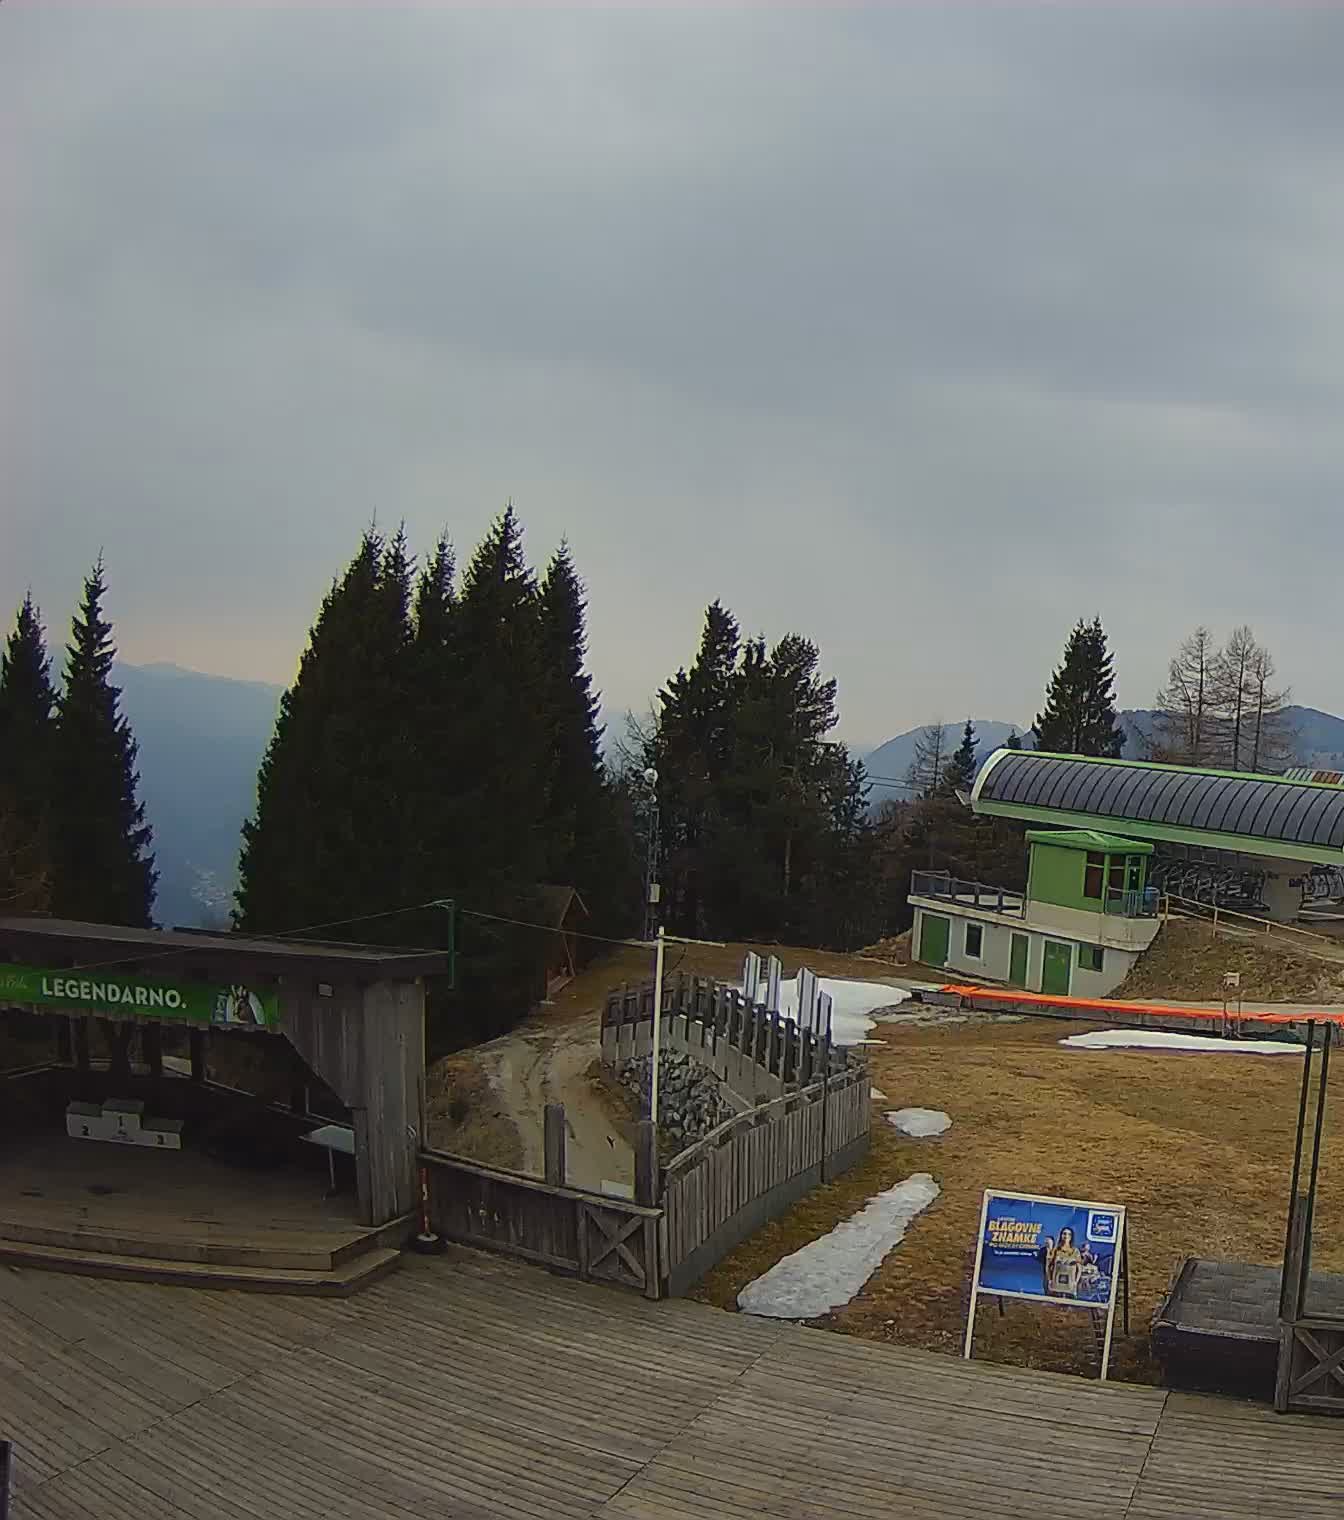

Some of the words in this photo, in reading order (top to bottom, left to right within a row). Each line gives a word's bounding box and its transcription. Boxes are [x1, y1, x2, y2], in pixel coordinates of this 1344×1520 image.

[41, 976, 188, 1009] LEGENDARNO.
[988, 1220, 1043, 1234] BLAGOVNE
[991, 1231, 1038, 1244] ZNAMKE
